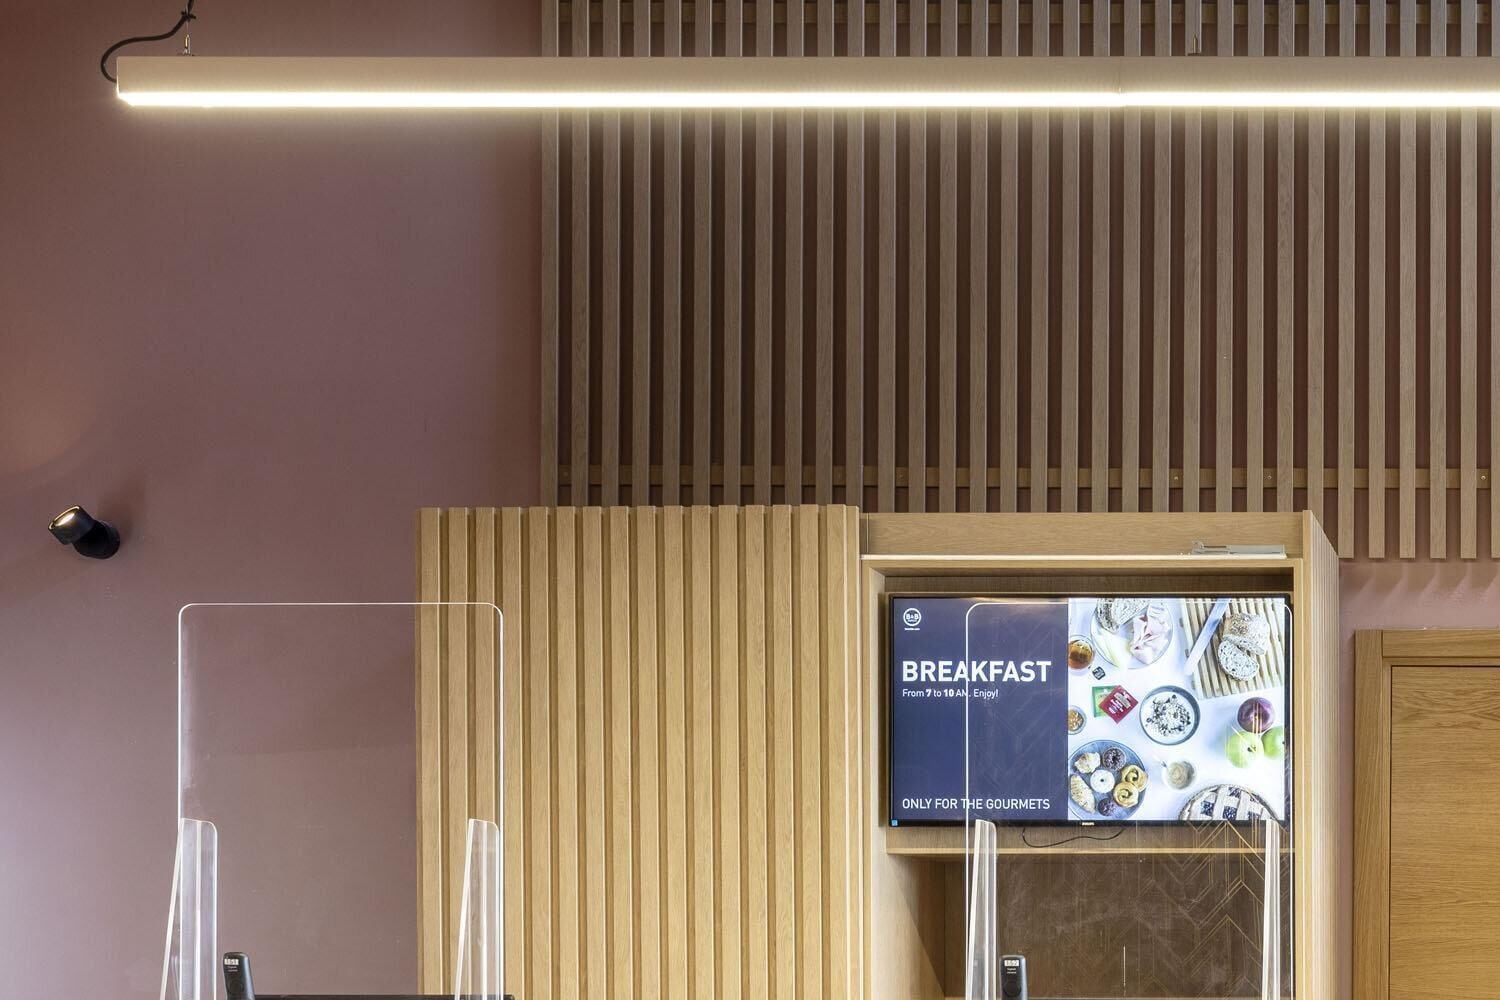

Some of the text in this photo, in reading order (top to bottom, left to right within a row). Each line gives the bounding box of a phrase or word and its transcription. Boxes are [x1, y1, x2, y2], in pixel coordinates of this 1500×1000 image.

[902, 660, 1051, 682] BREAKFAST
[902, 688, 924, 697] From
[926, 688, 932, 697] 7
[933, 688, 941, 697] to
[944, 688, 954, 697] 10
[974, 688, 999, 700] Enjoy!
[902, 798, 1050, 810] ONLY FOR THE GOURMETS
